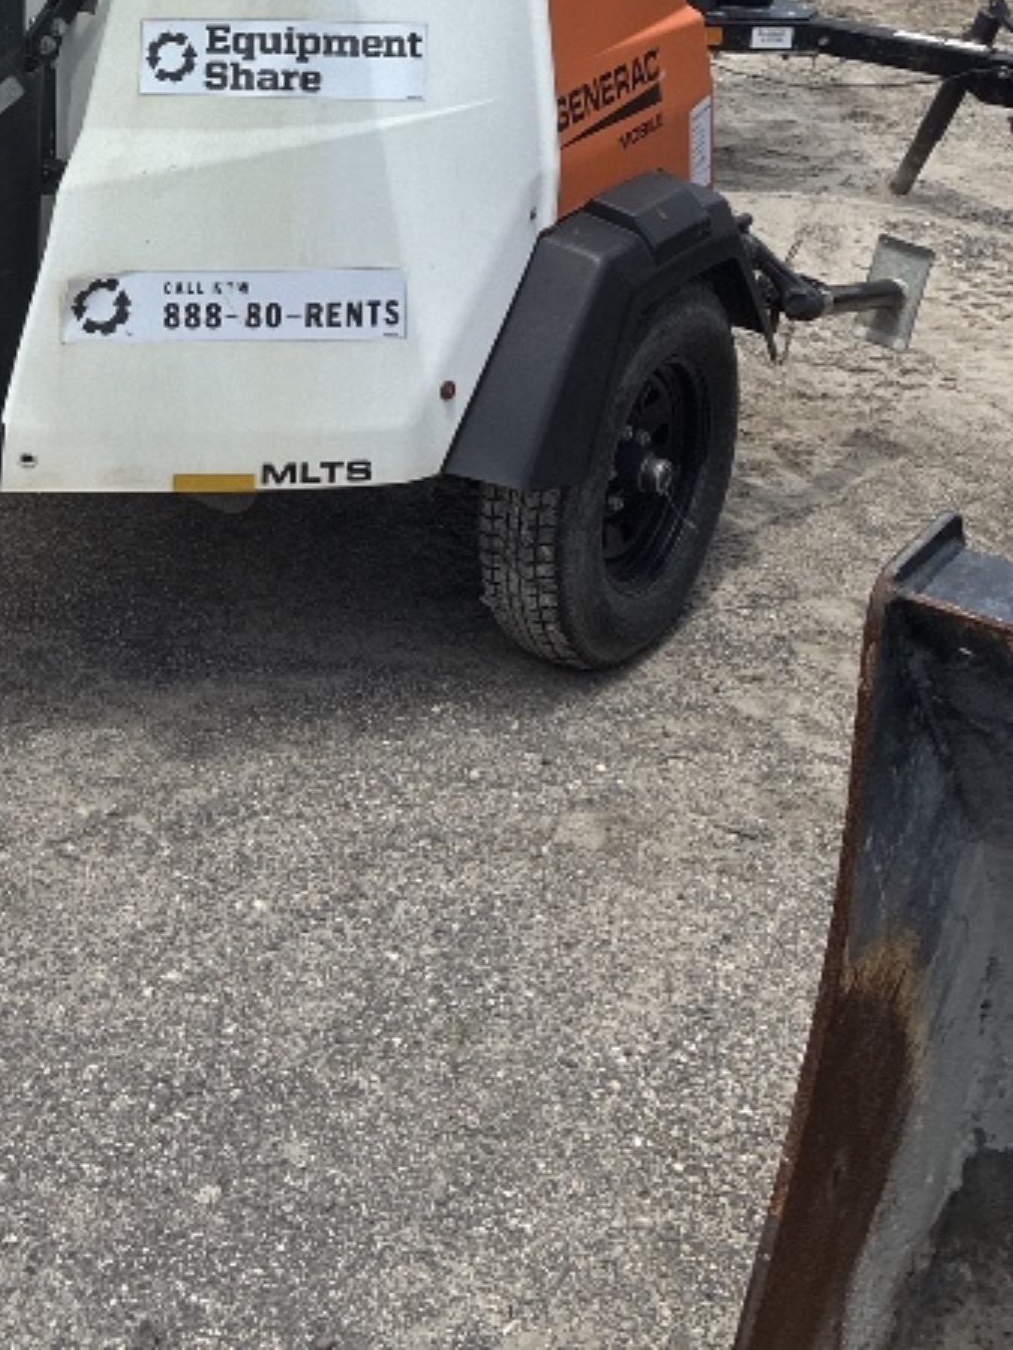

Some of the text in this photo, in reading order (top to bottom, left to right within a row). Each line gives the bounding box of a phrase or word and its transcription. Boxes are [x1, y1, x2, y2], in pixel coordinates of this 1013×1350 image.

[205, 24, 424, 62] Equipment
[204, 62, 322, 92] Share
[163, 281, 204, 295] CALL
[163, 299, 400, 330] 888-80-RENTS
[261, 460, 372, 486] MLTS
